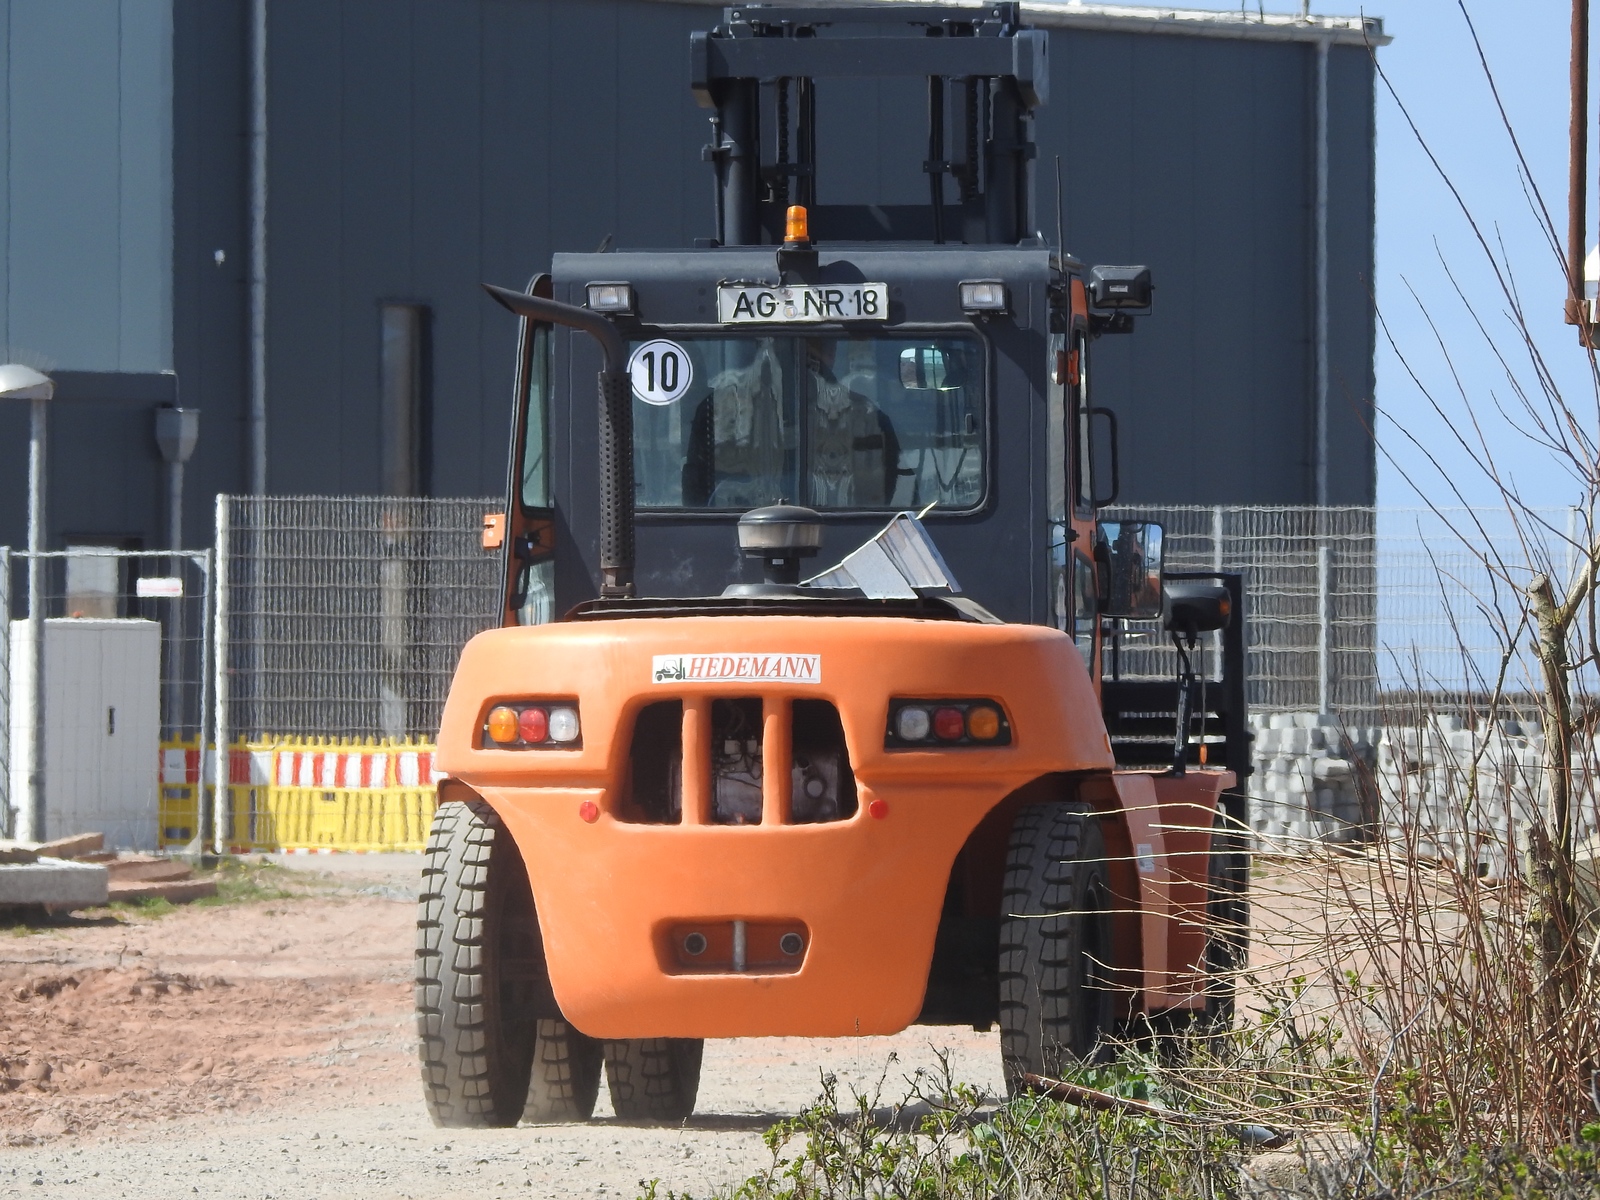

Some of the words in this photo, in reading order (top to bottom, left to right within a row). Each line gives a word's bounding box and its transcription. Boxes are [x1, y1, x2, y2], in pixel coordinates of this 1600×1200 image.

[732, 291, 776, 318] AG
[642, 351, 679, 393] 10
[687, 656, 818, 678] HEDEMANN
